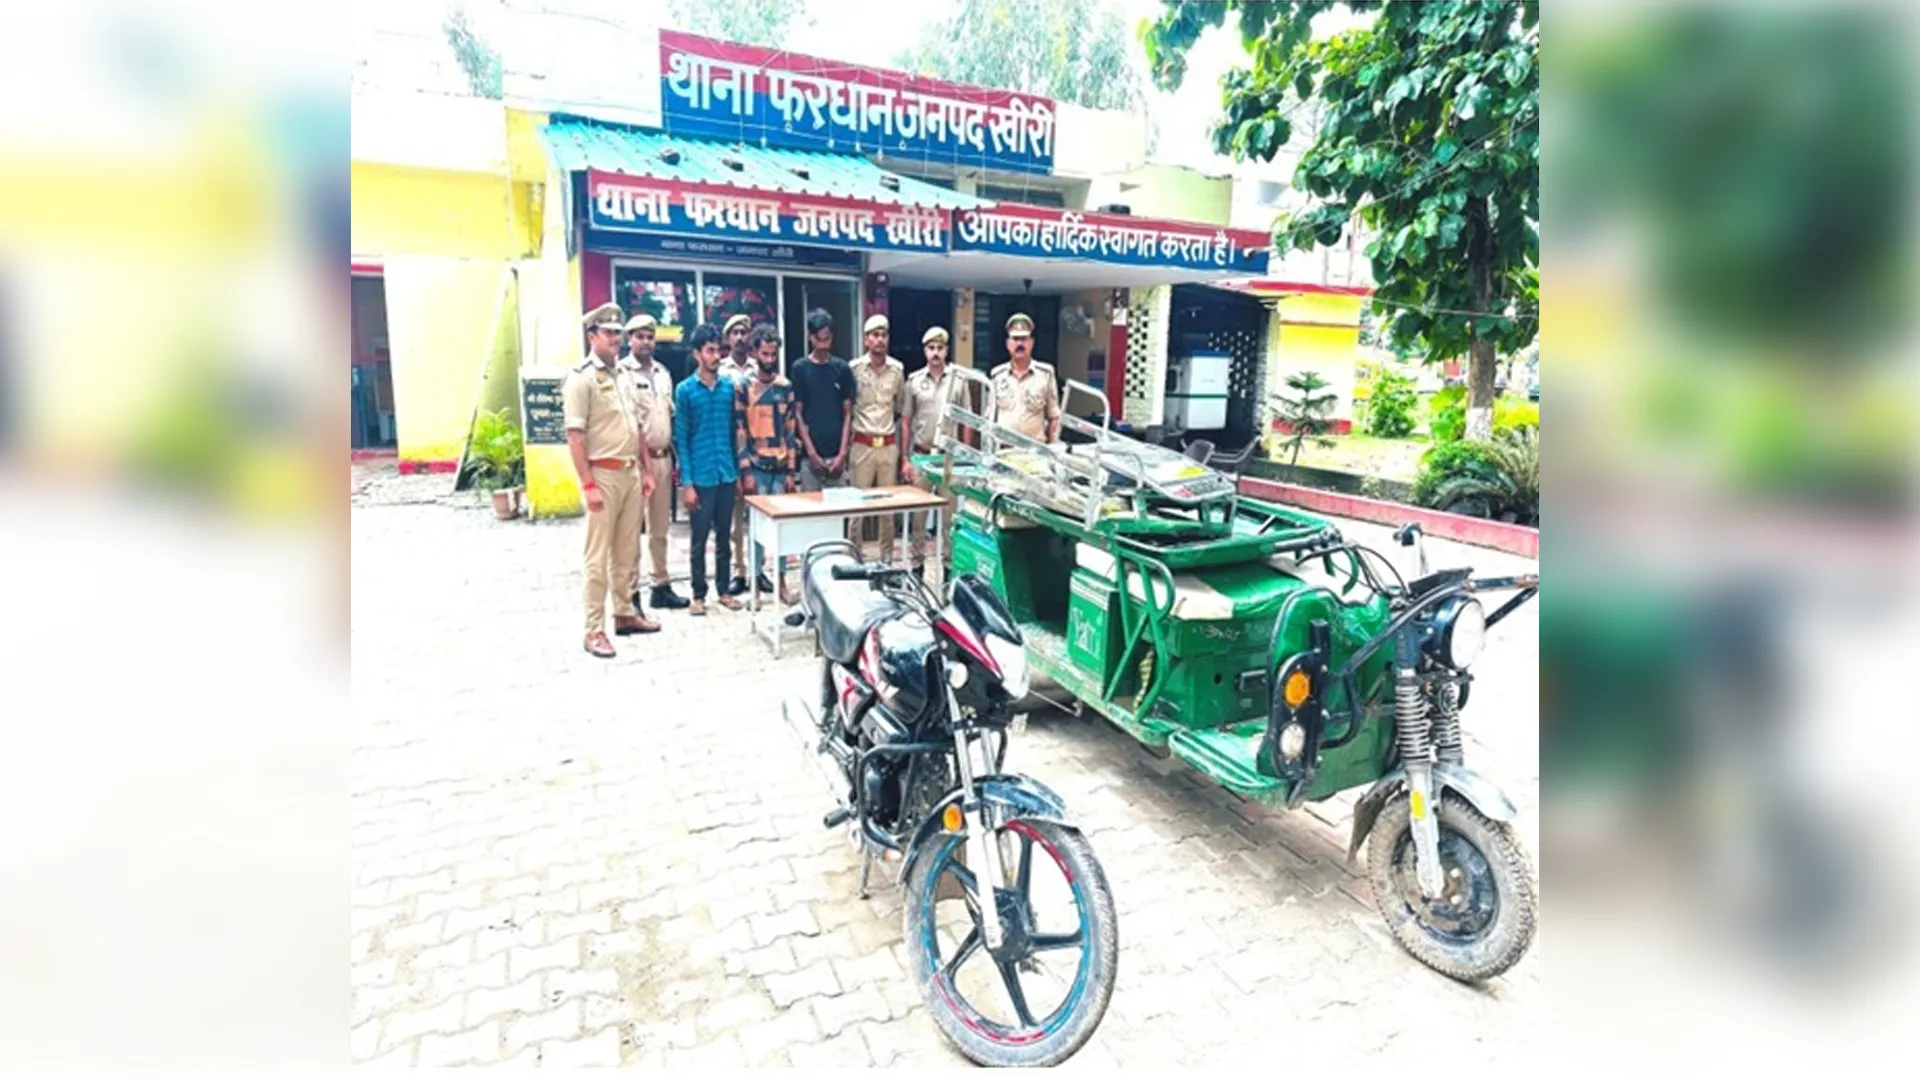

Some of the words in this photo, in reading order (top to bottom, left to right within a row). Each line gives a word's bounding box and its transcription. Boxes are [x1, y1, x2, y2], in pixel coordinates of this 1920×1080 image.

[667, 51, 758, 117] थाना
[765, 67, 898, 136] फरधान
[896, 91, 987, 149] जनपद
[987, 96, 1055, 157] खीरी
[596, 183, 672, 224] थाना
[681, 190, 782, 233] फरधान
[788, 202, 876, 244] जनपद
[883, 205, 944, 248] खीरी
[957, 209, 1040, 247] आपका
[1039, 212, 1100, 253] हार्दिक
[1098, 227, 1159, 257] स्वागत
[1160, 231, 1213, 263] करता
